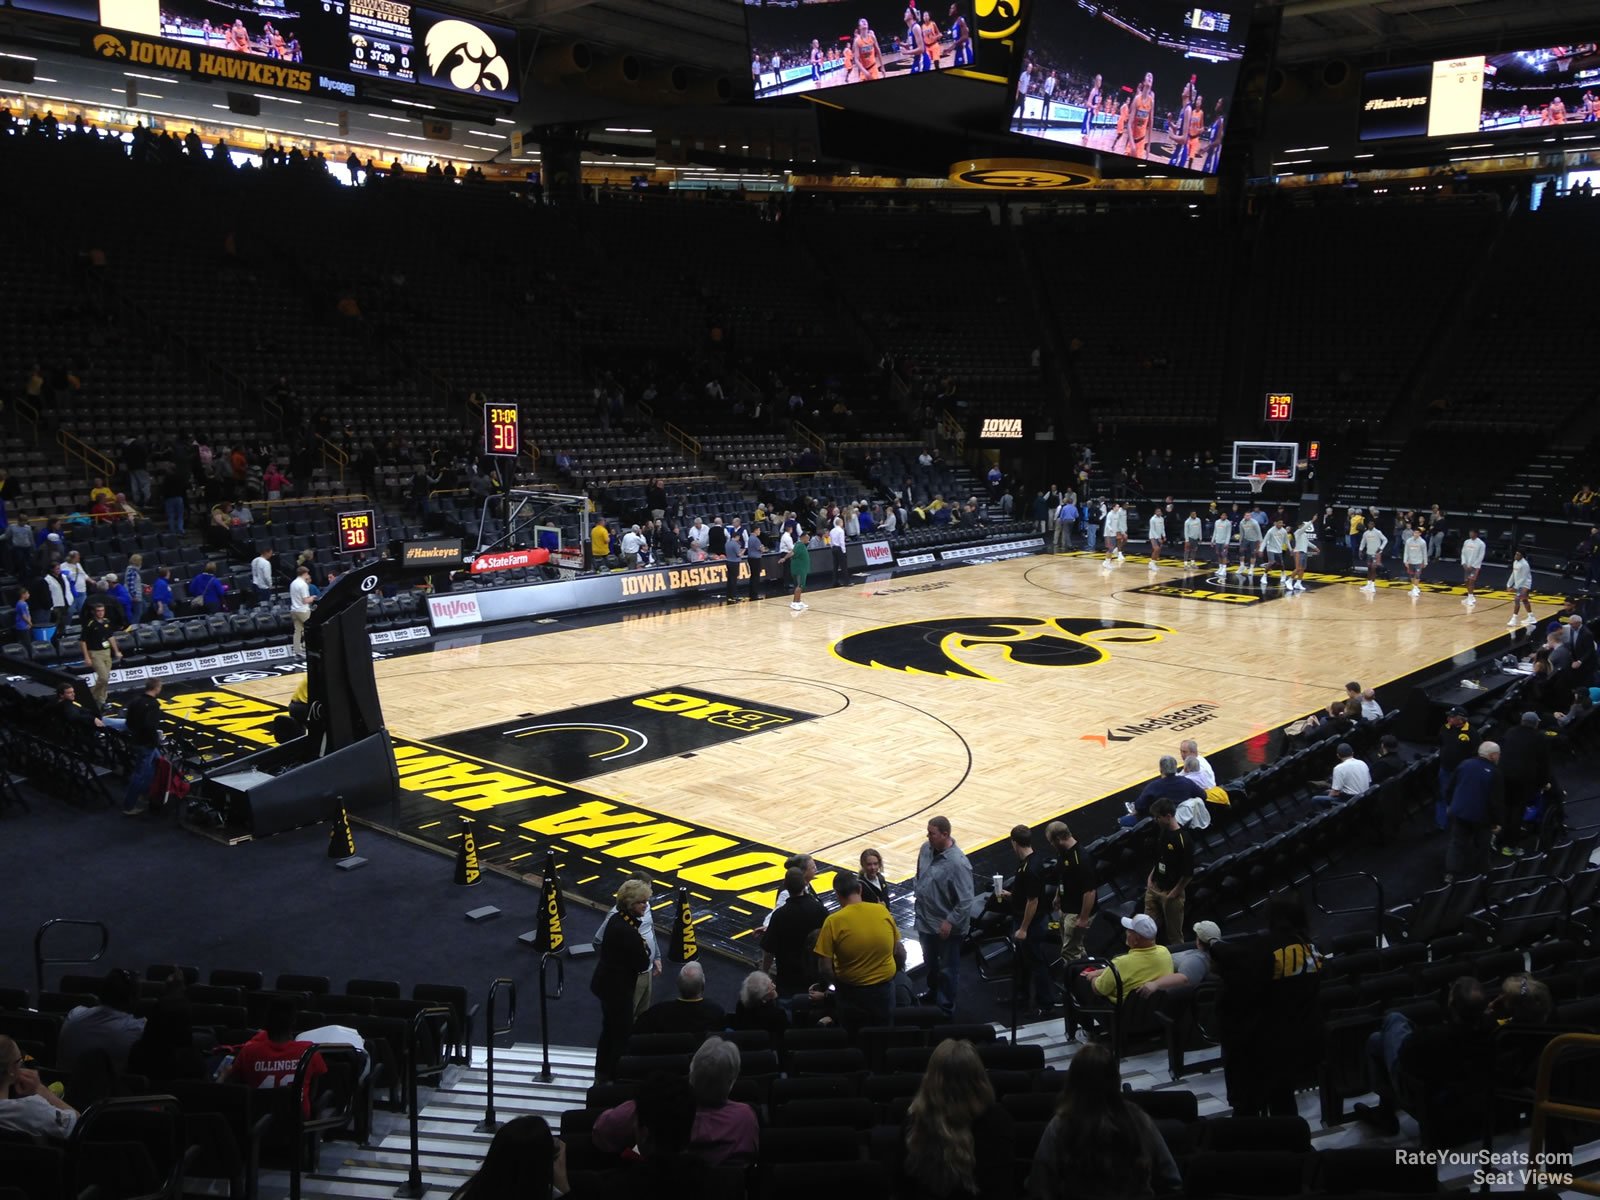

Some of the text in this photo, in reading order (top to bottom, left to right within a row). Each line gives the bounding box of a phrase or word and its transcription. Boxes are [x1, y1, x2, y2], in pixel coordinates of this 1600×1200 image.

[370, 50, 396, 64] 37:09
[128, 39, 312, 92] IOWA HAWKEYES
[1364, 96, 1428, 112] #Hawkeyes
[1269, 396, 1291, 404] 37:09
[491, 409, 516, 424] 37:09
[1271, 404, 1288, 418] 30
[982, 418, 1022, 432] IOWA
[494, 424, 514, 450] 30
[341, 515, 369, 530] 37:09
[347, 529, 365, 546] 30
[406, 547, 460, 559] #Hawkeyes
[621, 572, 667, 597] IOWA
[200, 657, 216, 665] zero
[246, 650, 262, 658] zero
[125, 669, 143, 677] zero
[151, 665, 168, 673] zero
[1115, 703, 1222, 736] Mediacom
[1169, 713, 1219, 732] COURT
[464, 832, 481, 884] IOWA
[547, 889, 565, 950] IOWA
[682, 902, 698, 960] IOWA
[254, 1059, 301, 1072] OLLINGE
